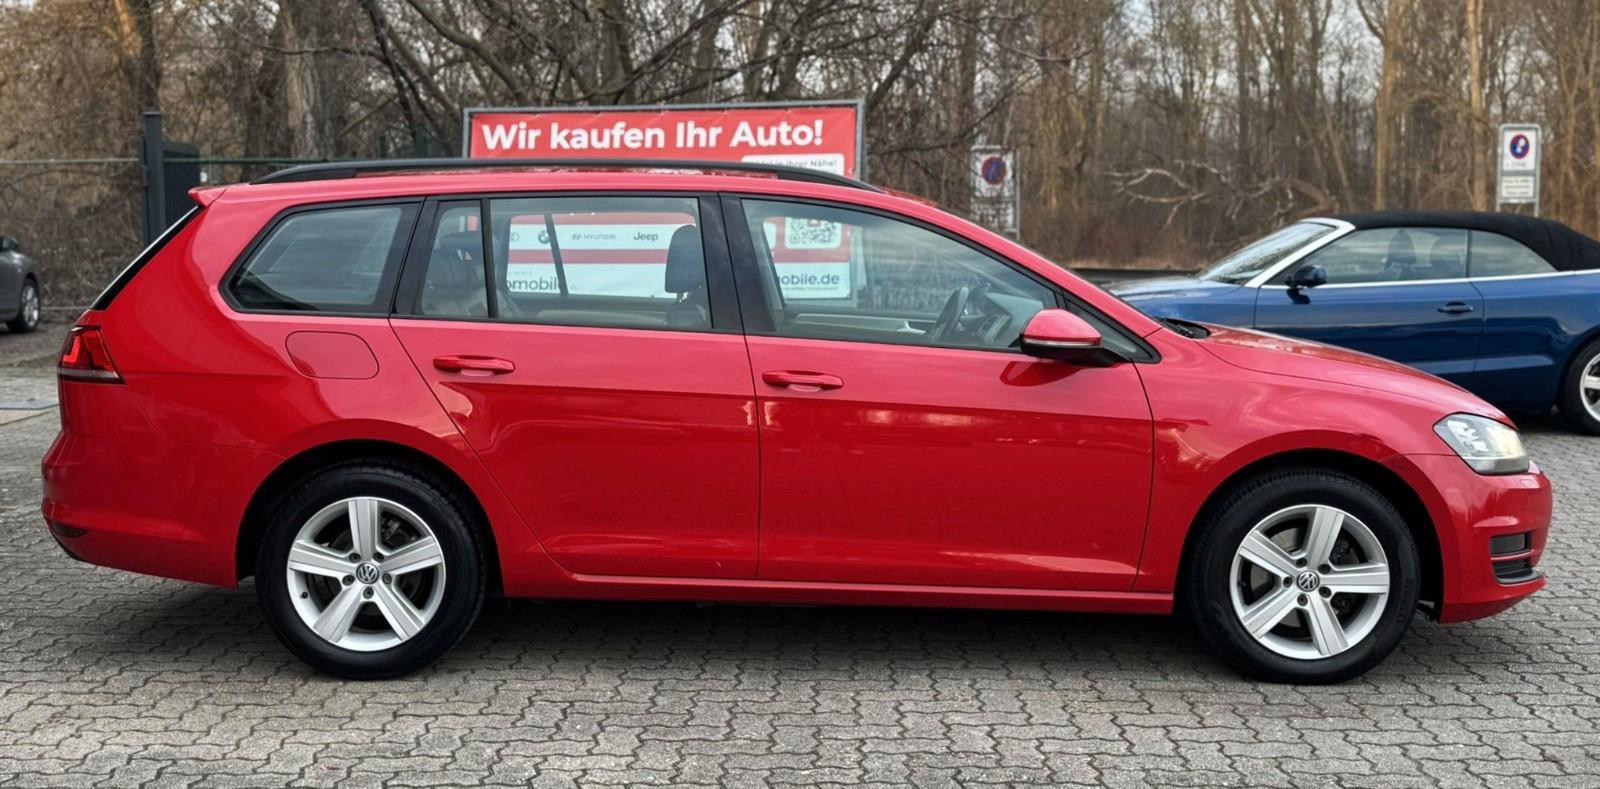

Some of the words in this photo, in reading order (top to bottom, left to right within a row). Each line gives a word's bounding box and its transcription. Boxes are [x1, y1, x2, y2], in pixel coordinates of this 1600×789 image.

[481, 121, 542, 150] Wir
[551, 121, 665, 149] kaufen
[676, 120, 723, 148] Ihr
[729, 119, 824, 147] Auto!
[633, 231, 659, 242] Jeep
[506, 276, 560, 290] omobil
[778, 273, 840, 285] obile.de
